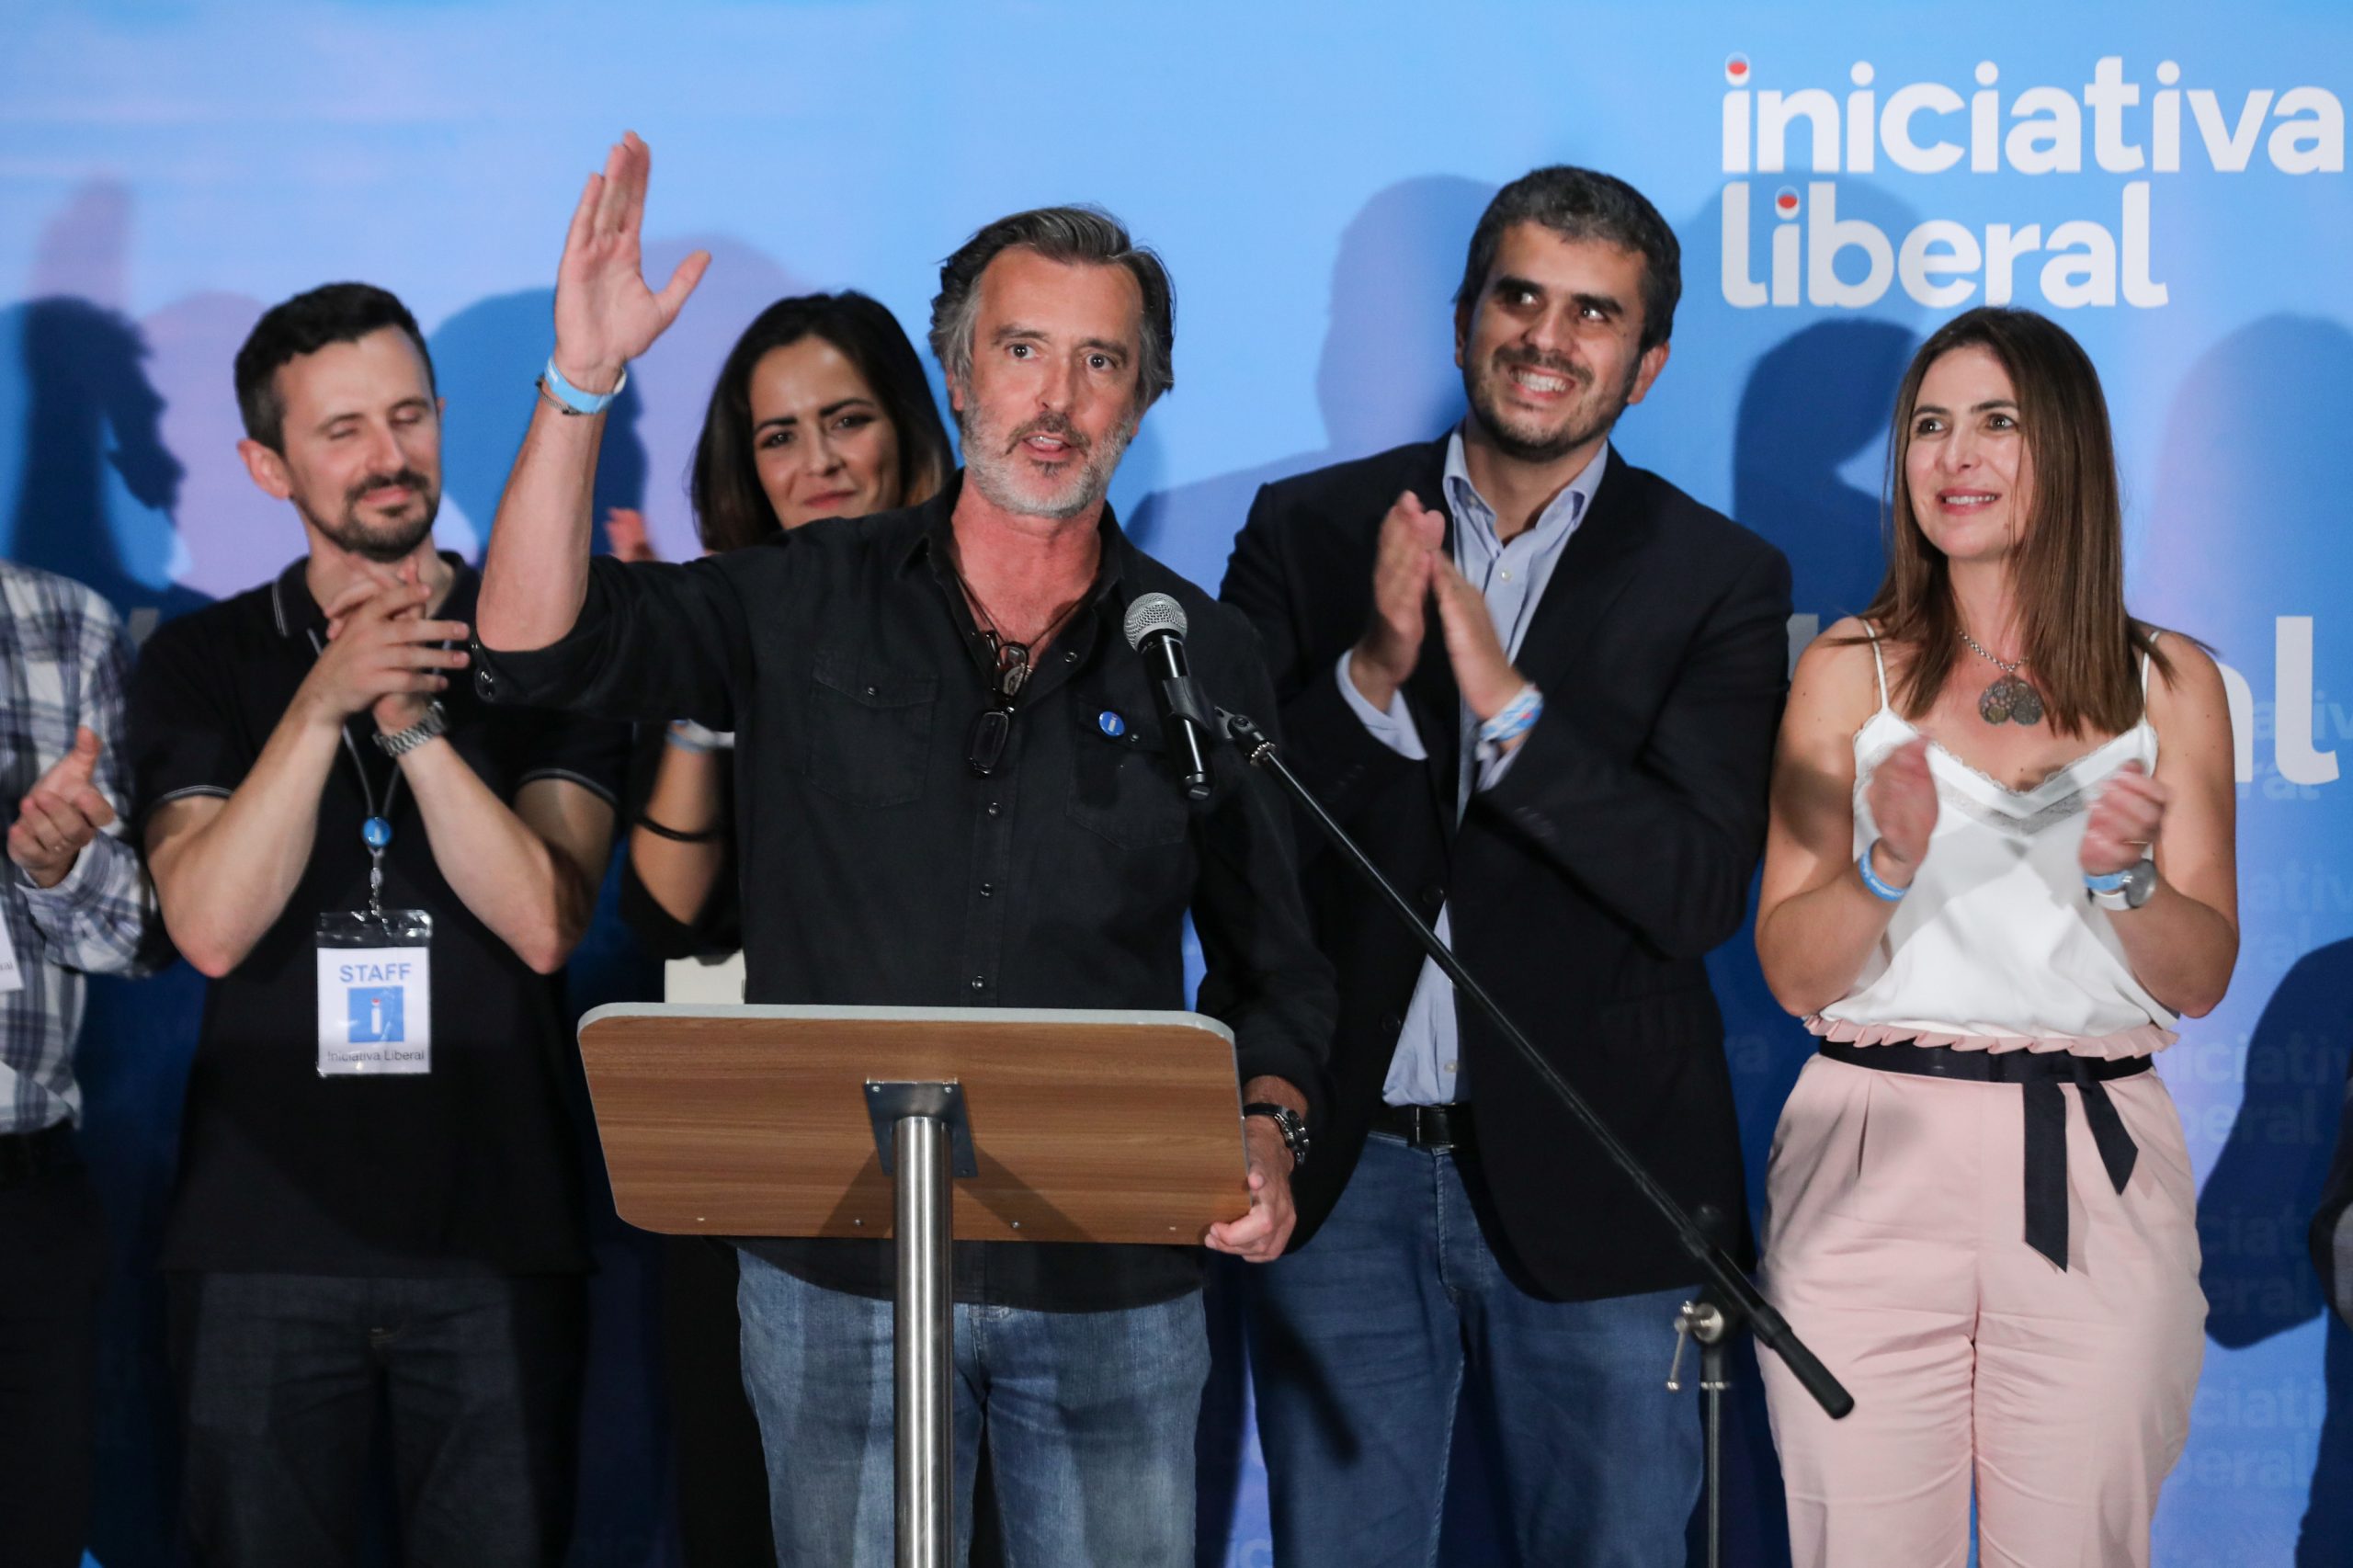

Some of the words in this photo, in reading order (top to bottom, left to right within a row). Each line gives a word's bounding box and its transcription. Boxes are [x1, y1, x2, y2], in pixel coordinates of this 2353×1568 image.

[1722, 52, 2346, 176] iniciativa
[1721, 181, 2169, 309] liberal
[339, 963, 412, 983] STAFF
